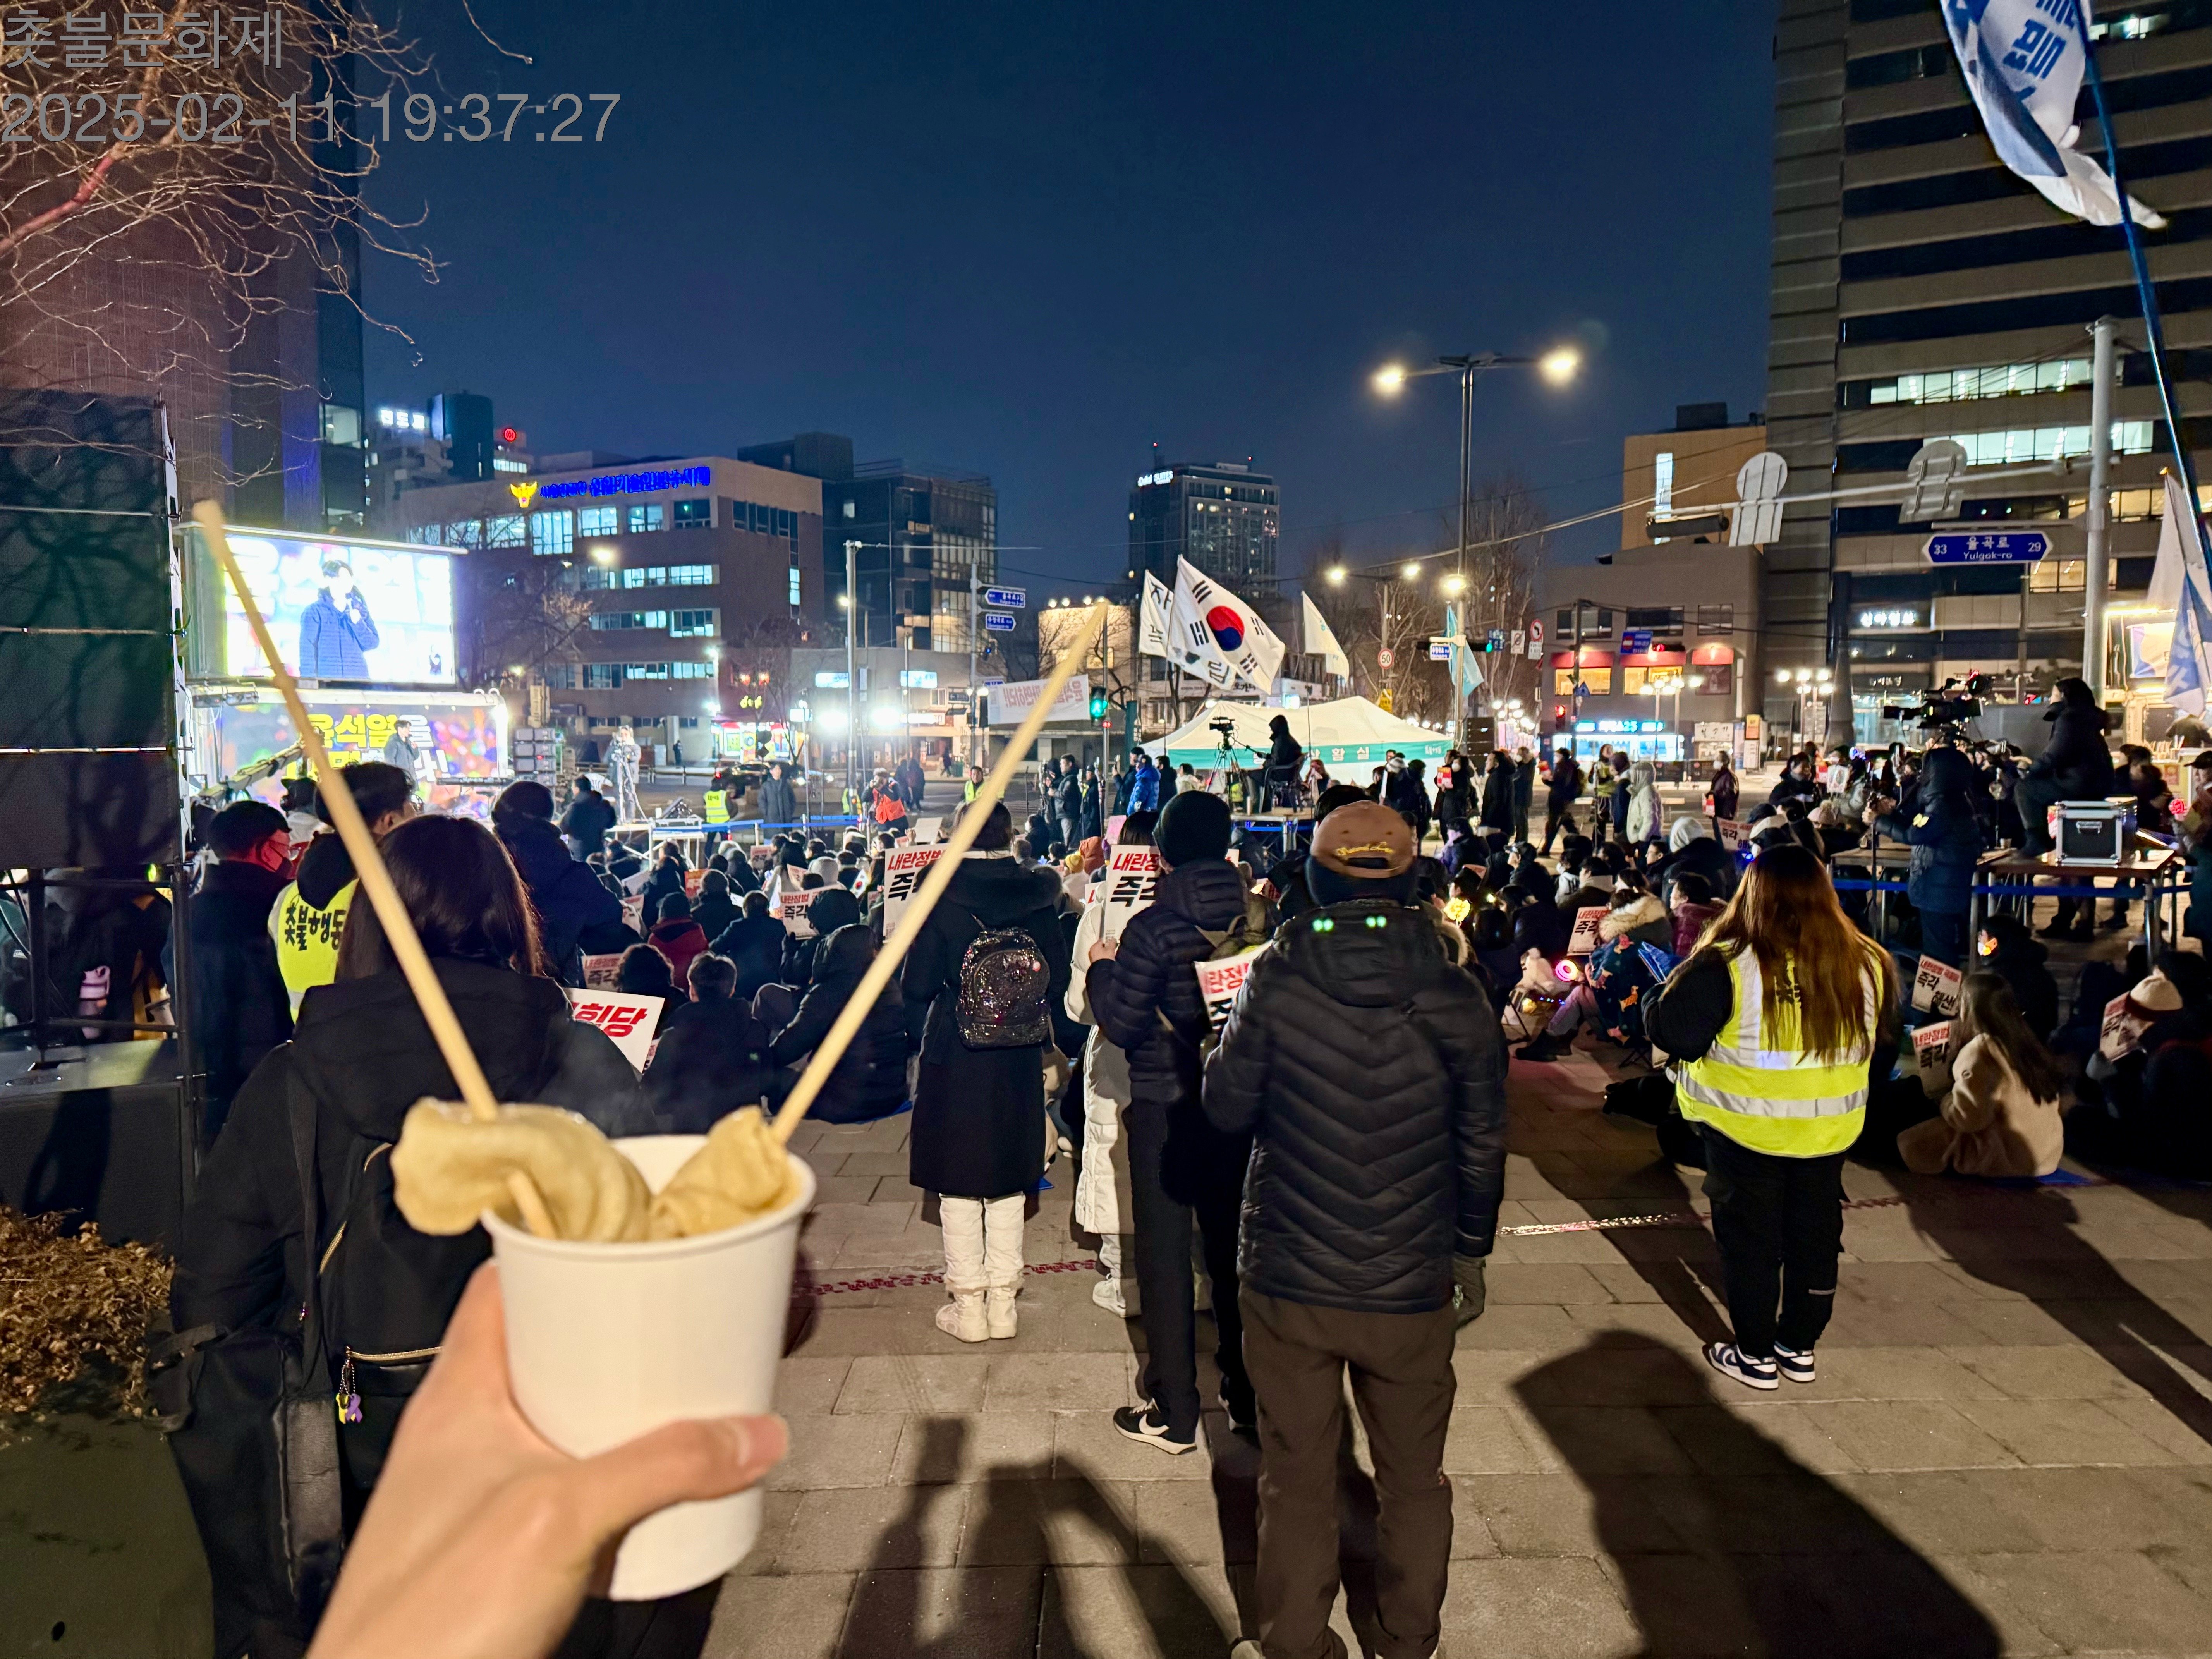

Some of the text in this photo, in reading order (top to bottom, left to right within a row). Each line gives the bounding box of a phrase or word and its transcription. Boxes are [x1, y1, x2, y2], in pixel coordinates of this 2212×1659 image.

[1934, 541, 2042, 562] 33 Yulgok-ro 29
[1966, 536, 2010, 551] 율곡로
[1382, 654, 1390, 663] 50
[1917, 970, 1940, 991] 즉각
